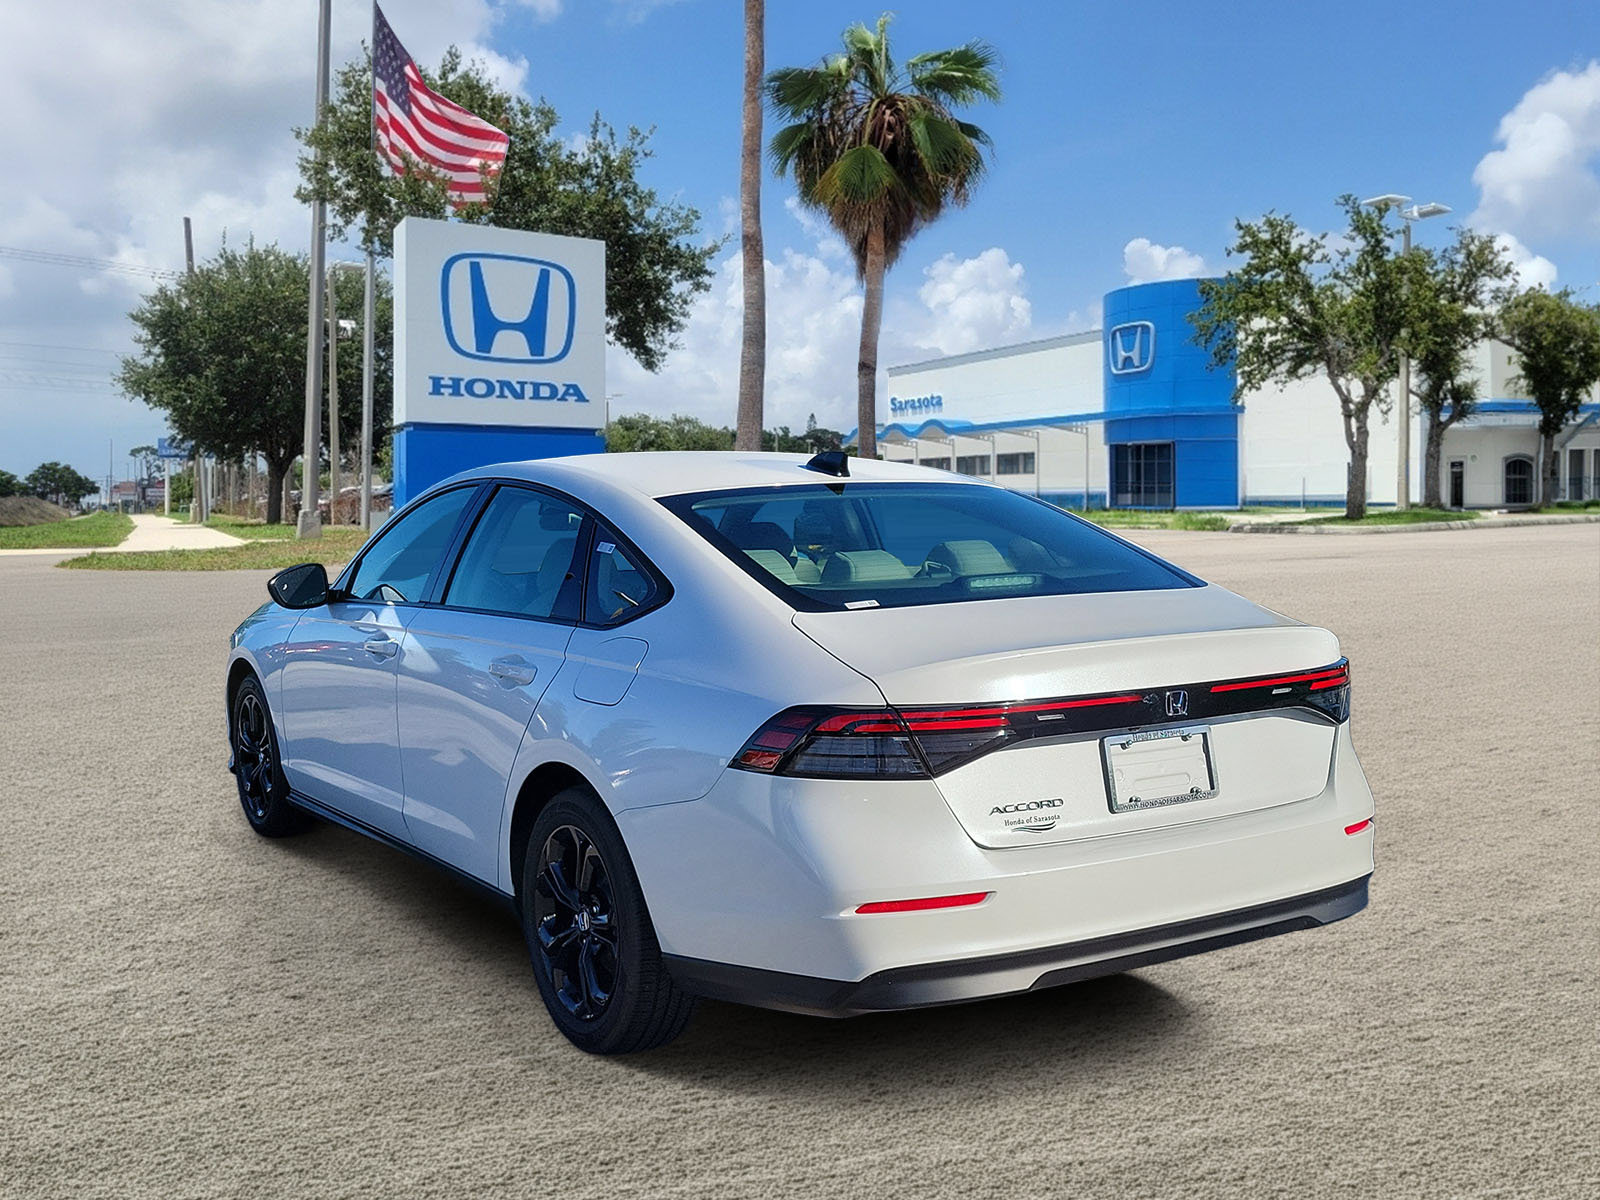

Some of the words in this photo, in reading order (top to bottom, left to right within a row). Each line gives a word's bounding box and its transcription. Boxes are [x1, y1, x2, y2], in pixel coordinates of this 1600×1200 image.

[428, 376, 589, 402] HONDA
[890, 394, 942, 411] Sarasota
[989, 798, 1064, 816] ACCORD
[1004, 818, 1025, 826] Honda
[1033, 814, 1061, 823] Sarasota
